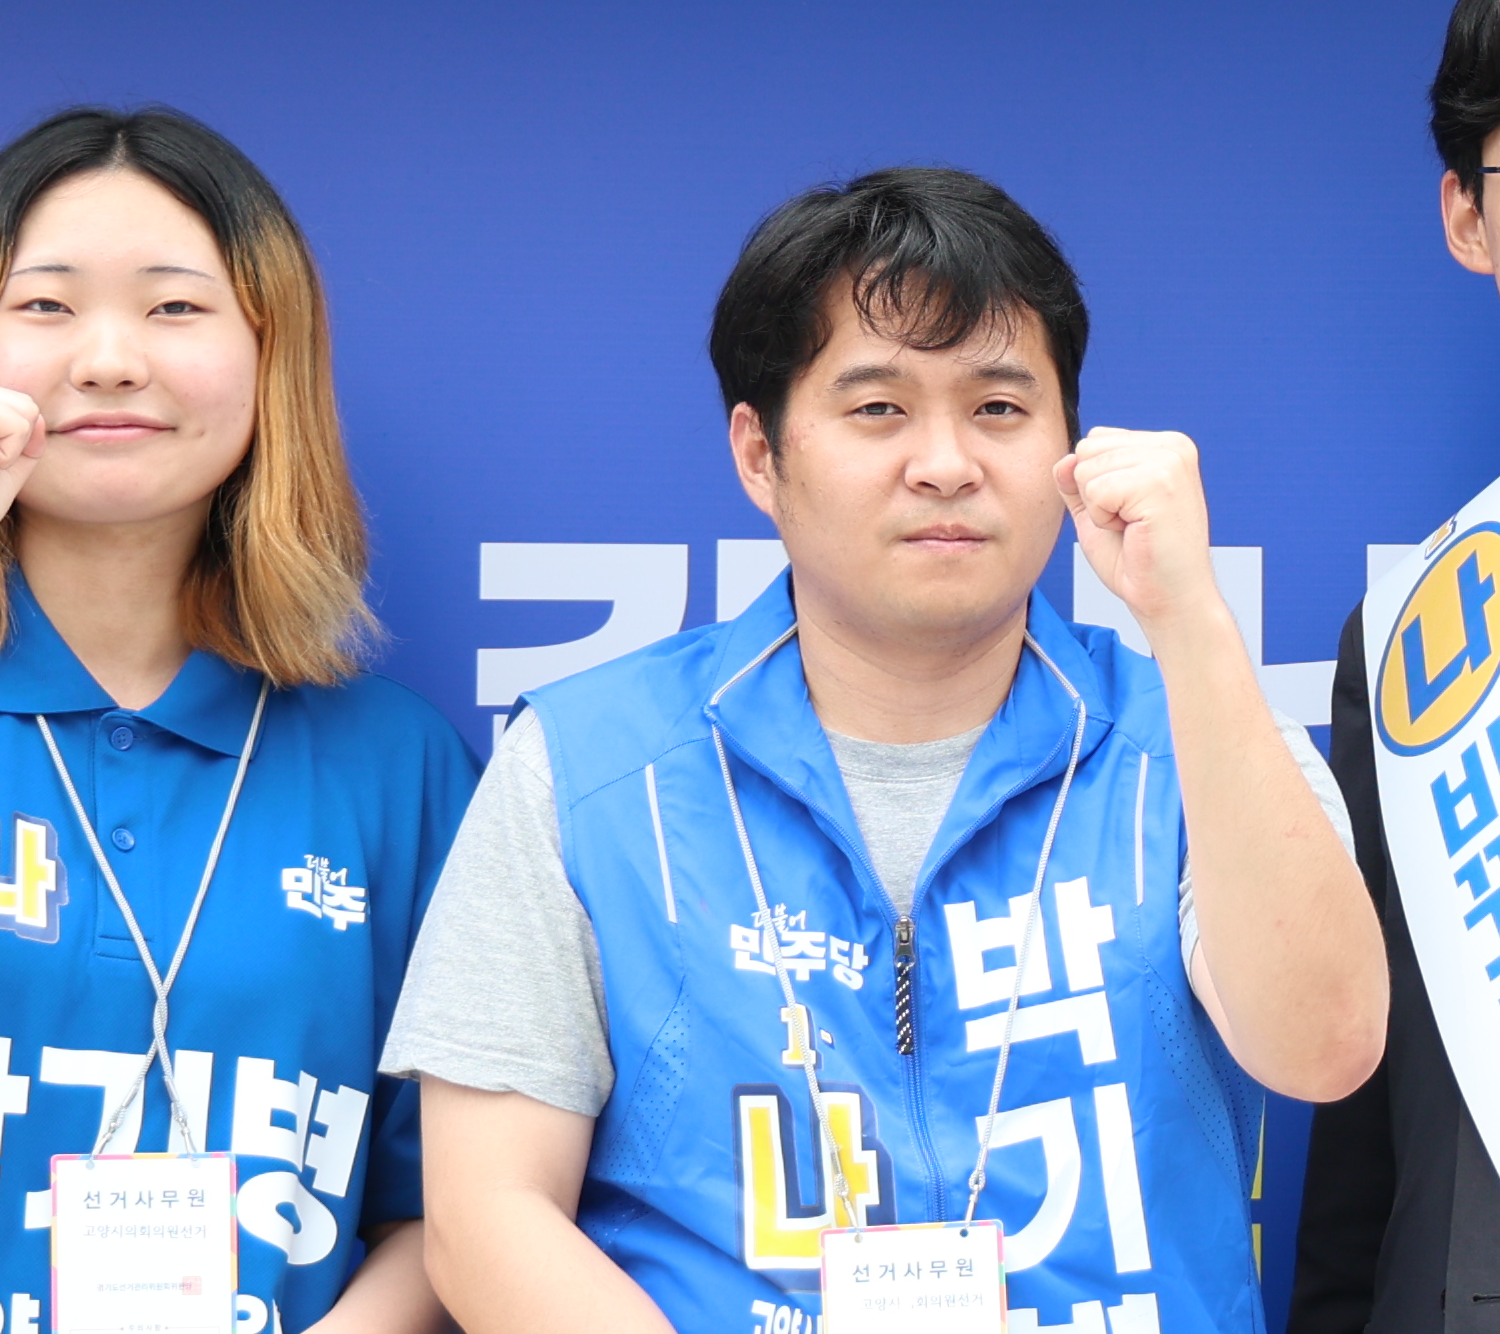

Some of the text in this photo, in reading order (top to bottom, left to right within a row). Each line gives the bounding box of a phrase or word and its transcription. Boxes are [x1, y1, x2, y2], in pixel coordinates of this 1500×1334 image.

[304, 853, 349, 886] 더불어
[730, 923, 870, 991] 민주당
[83, 1188, 206, 1211] 선거사무원
[83, 1223, 208, 1240] 고양시의회의원선거
[852, 1257, 975, 1284] 선거사무원
[861, 1292, 985, 1312] 고양시회의원선거
